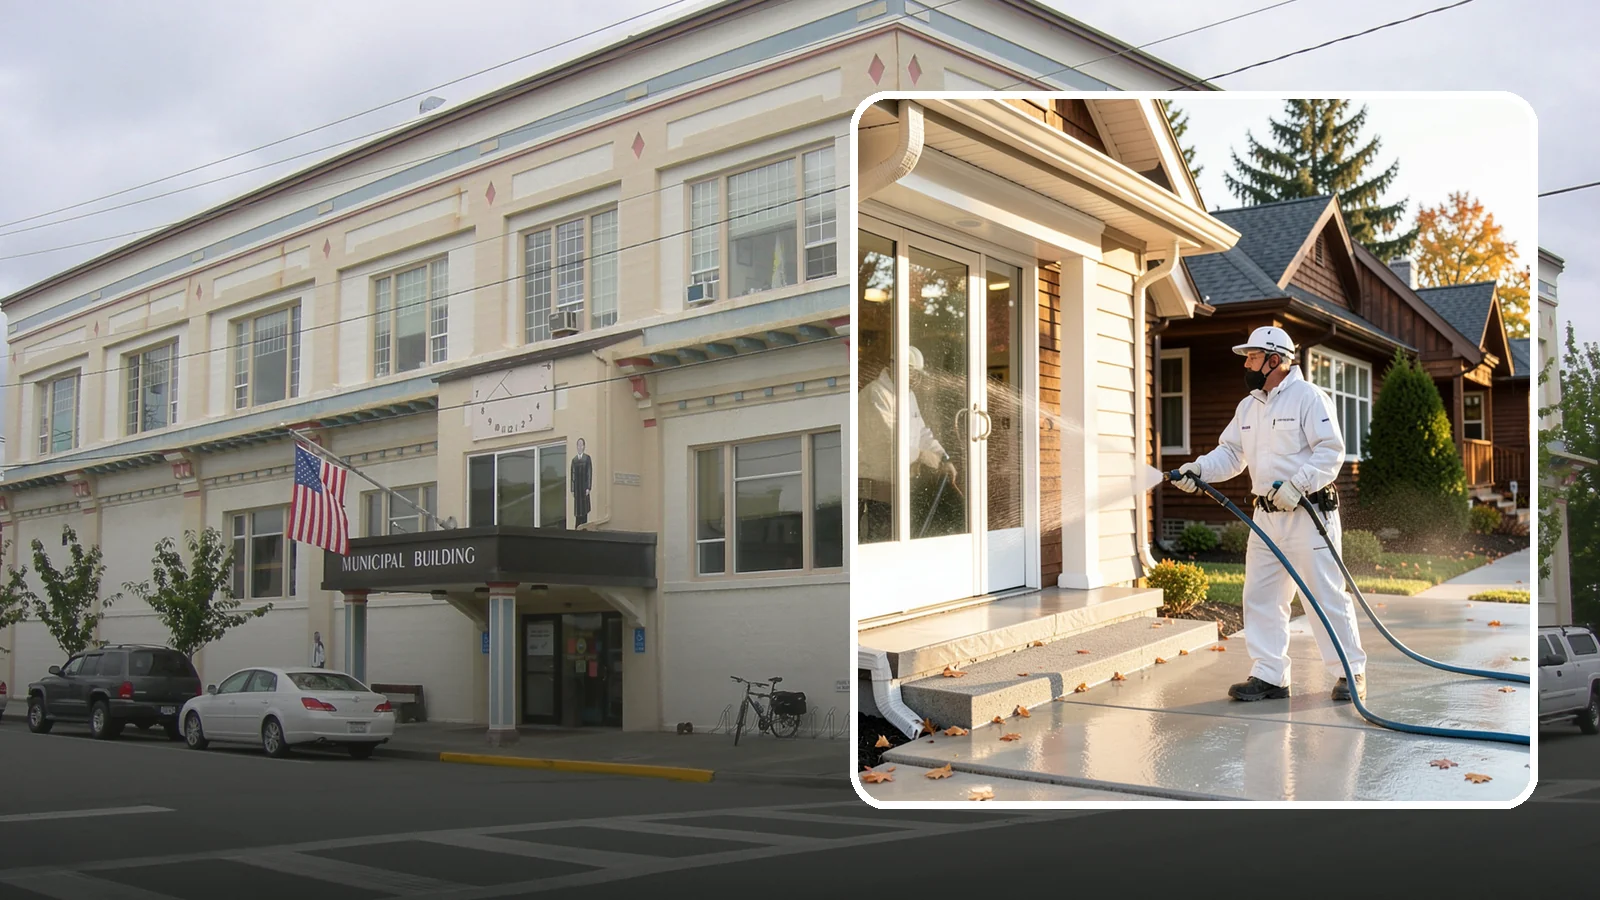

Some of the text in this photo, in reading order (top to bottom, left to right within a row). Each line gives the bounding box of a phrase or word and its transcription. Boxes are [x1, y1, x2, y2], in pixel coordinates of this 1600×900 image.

[529, 414, 532, 422] 3
[342, 546, 475, 572] MUNICIPAL BUILDING
